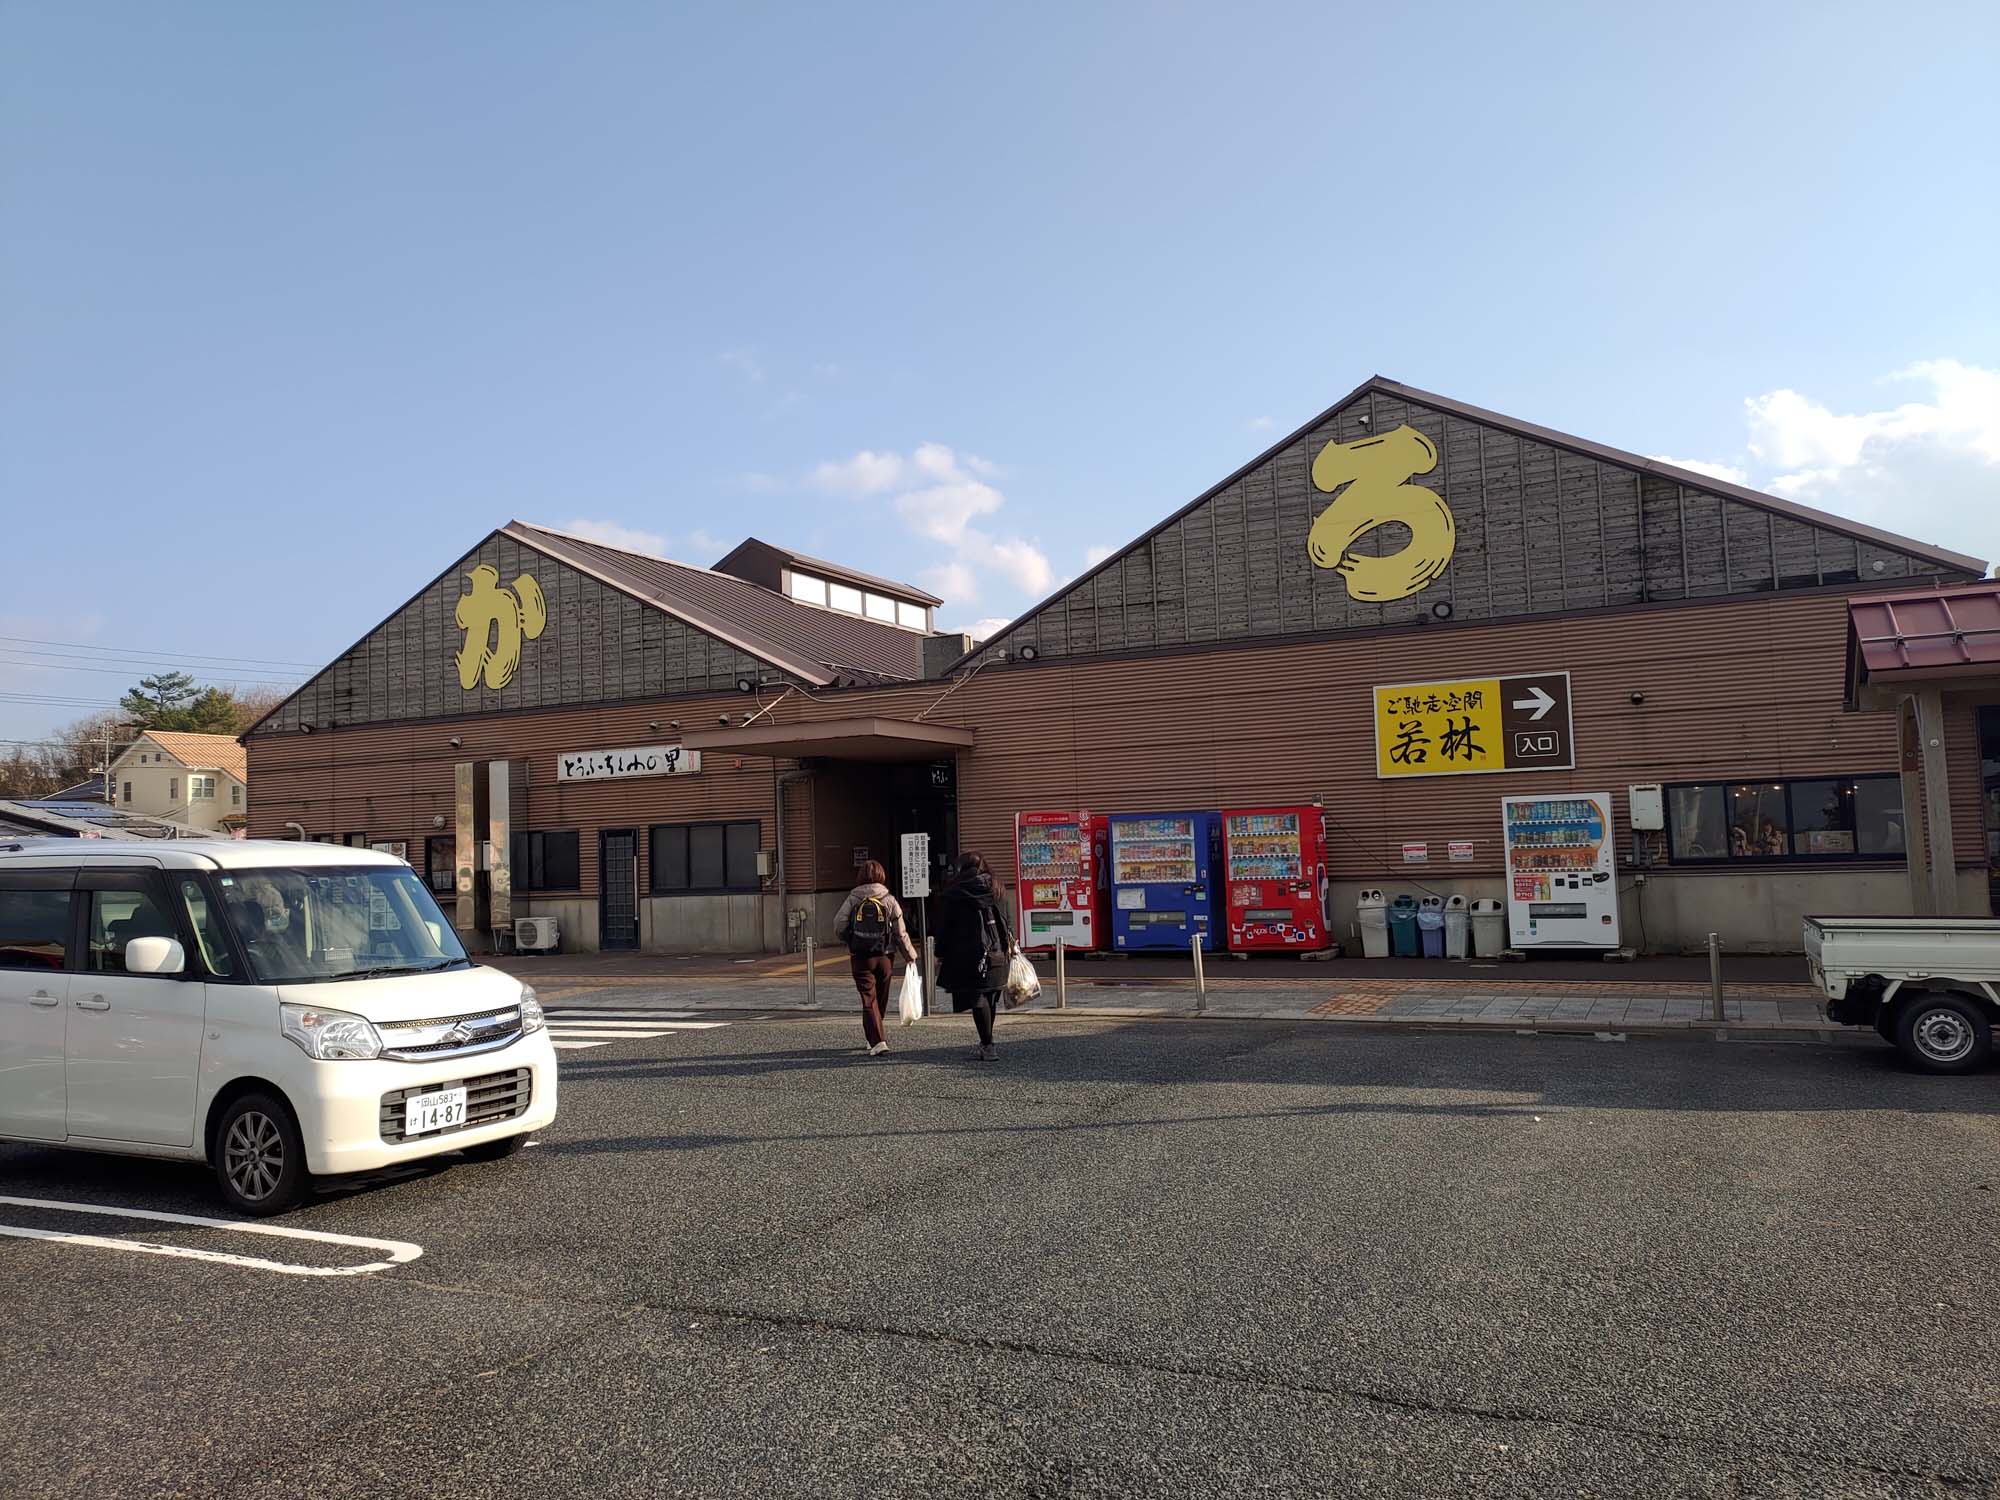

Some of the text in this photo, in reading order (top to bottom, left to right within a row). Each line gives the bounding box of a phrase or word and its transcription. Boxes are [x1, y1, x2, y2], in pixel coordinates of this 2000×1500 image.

[455, 564, 547, 690] か
[1387, 690, 1483, 715] ご馳走空間
[1389, 716, 1487, 765] 若林
[1521, 736, 1553, 753] 入口
[421, 1092, 453, 1108] 岡山 583
[421, 1103, 463, 1129] 14-87
